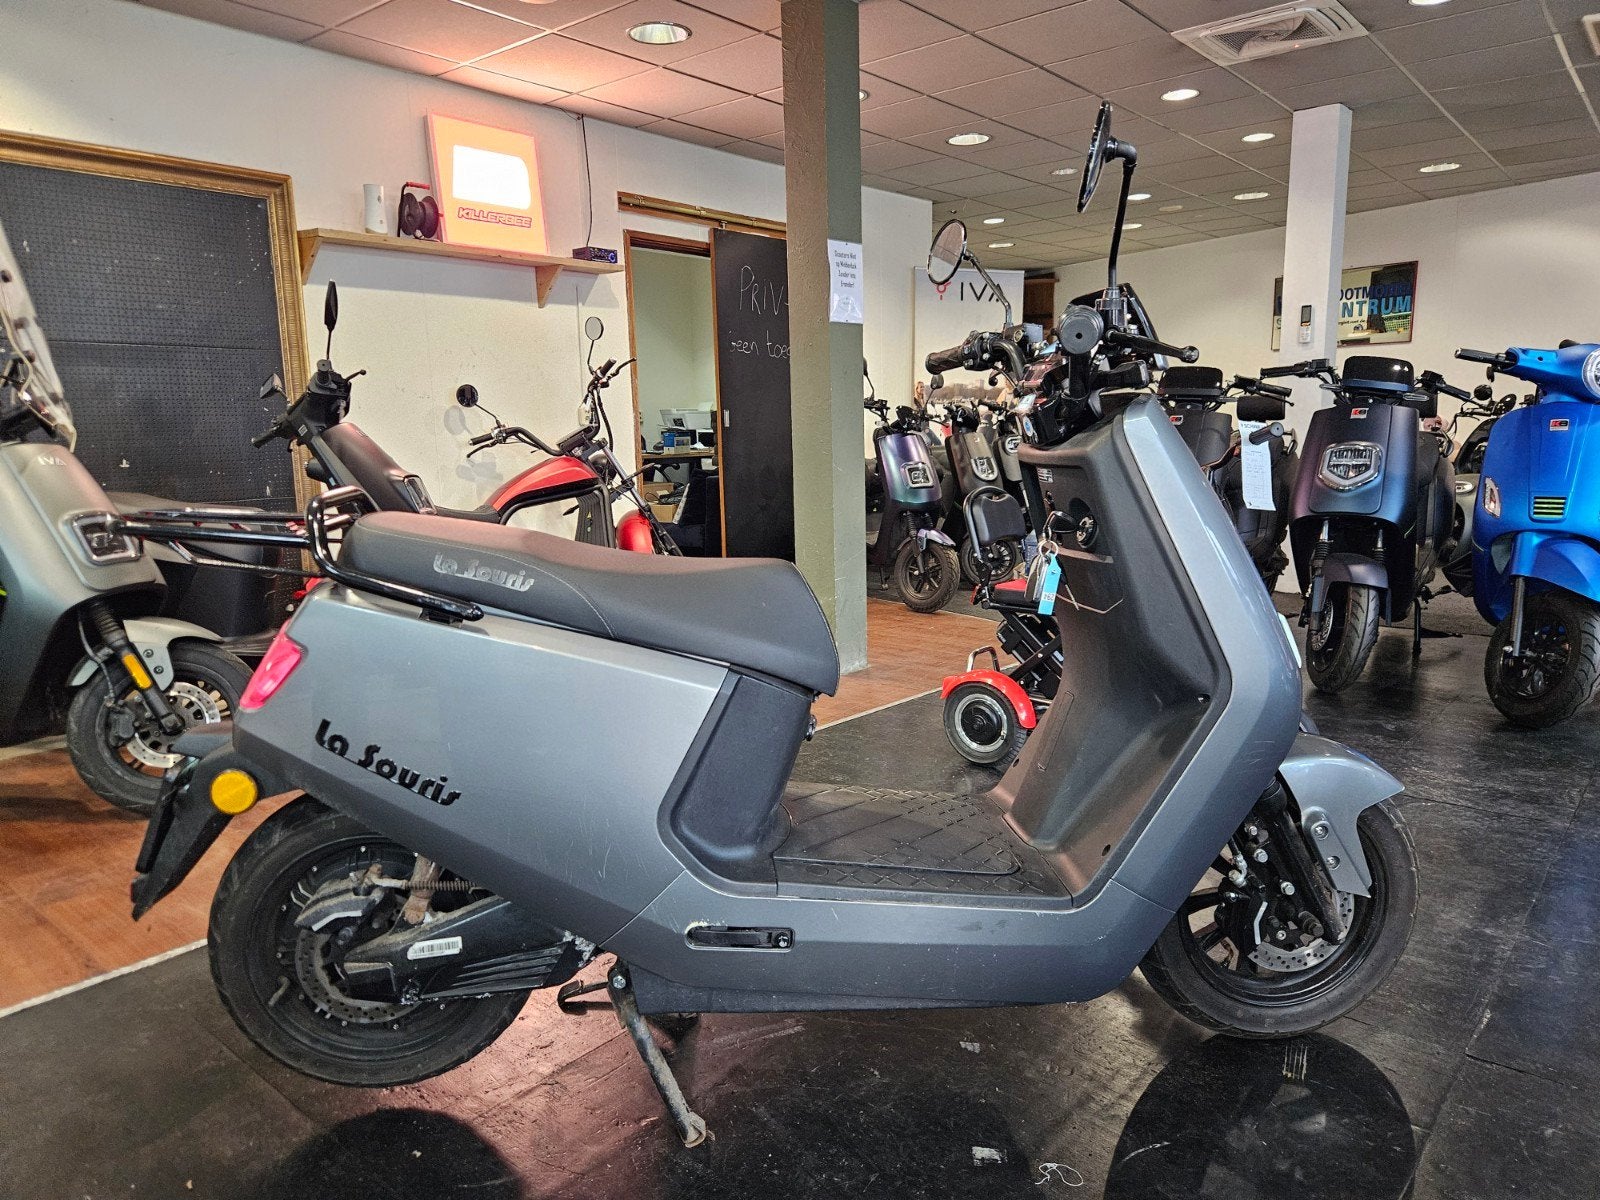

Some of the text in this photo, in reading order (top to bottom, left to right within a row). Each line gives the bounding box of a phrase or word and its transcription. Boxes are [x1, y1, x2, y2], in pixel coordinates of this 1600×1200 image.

[458, 207, 532, 228] KILLERBEE
[739, 265, 789, 315] PRIV
[1341, 295, 1412, 318] NTRUM
[433, 553, 535, 592] La Souris
[315, 718, 462, 806] La Souris
